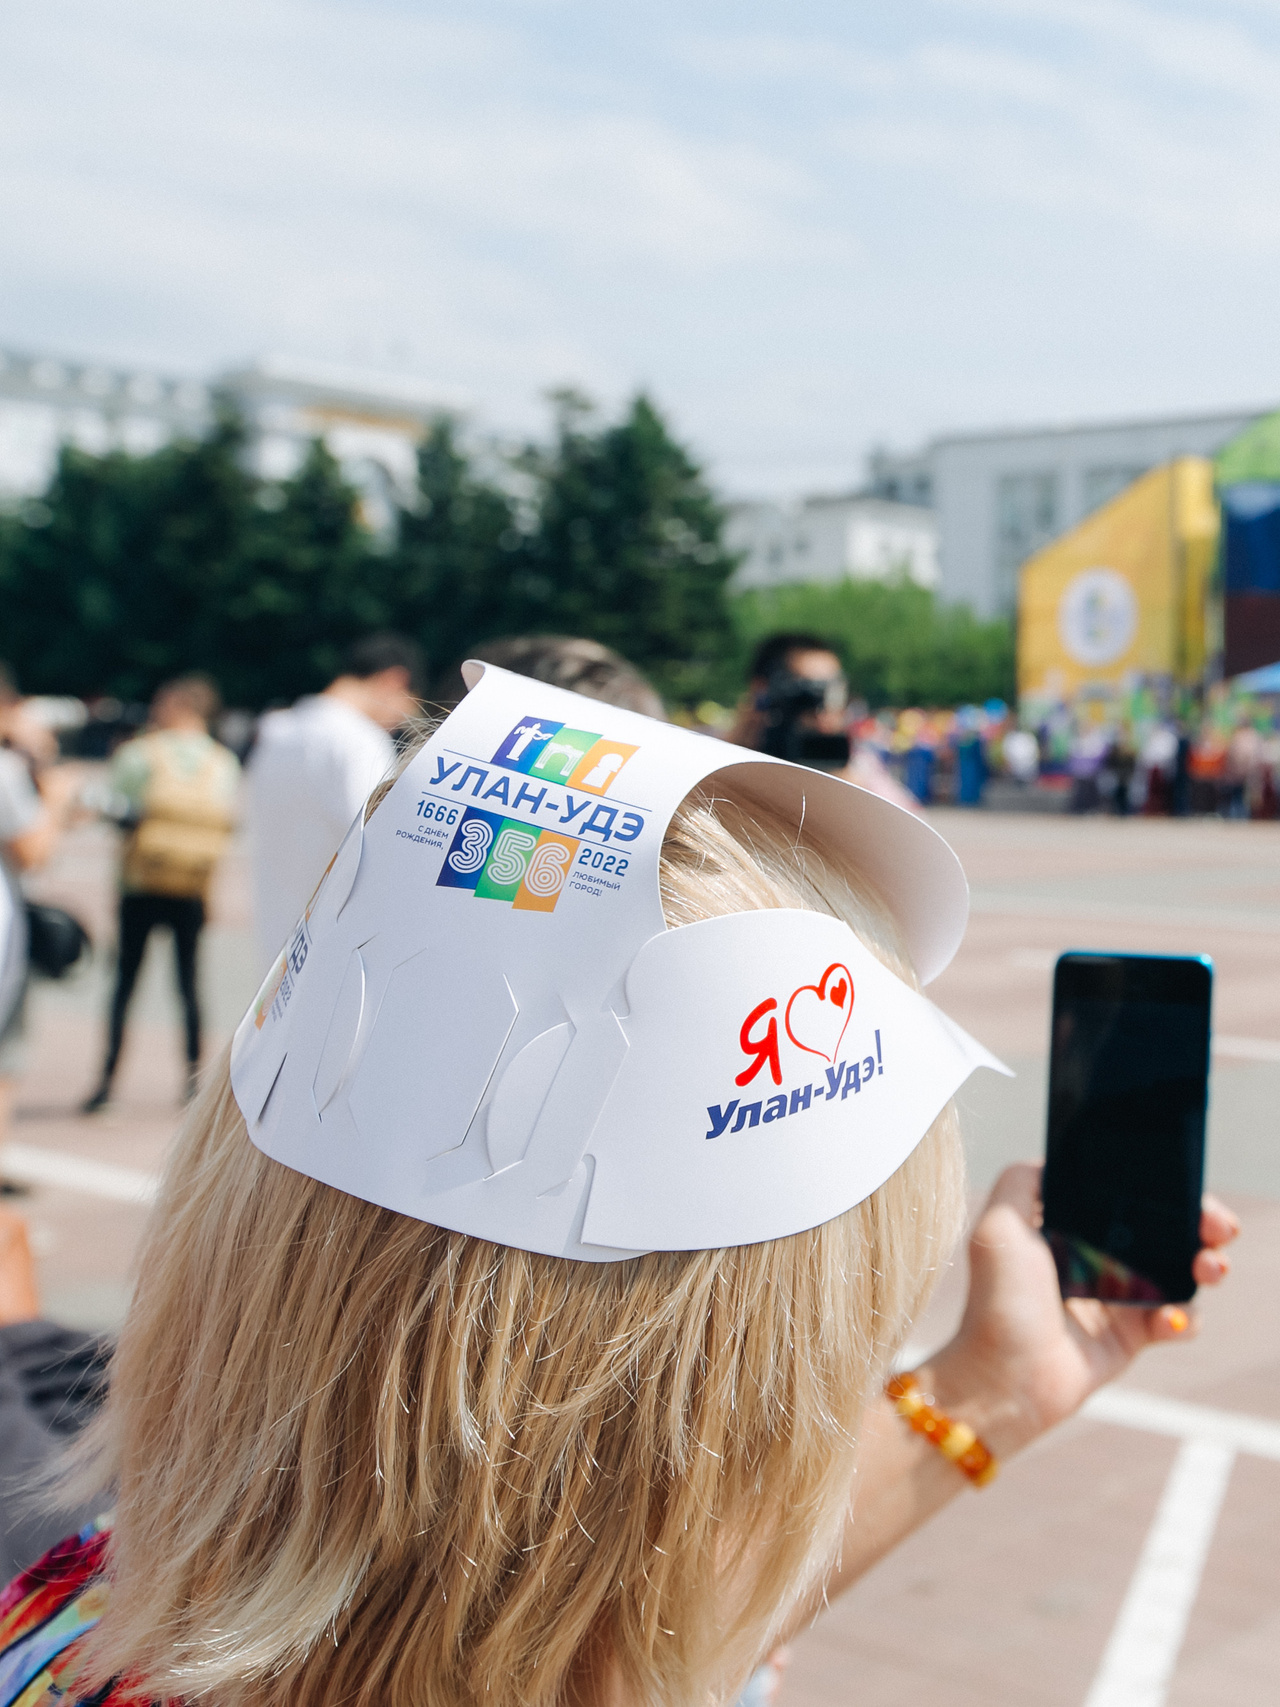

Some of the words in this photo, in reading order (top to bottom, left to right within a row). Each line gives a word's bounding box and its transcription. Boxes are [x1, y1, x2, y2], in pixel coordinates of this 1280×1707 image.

[416, 800, 459, 825] 1666
[429, 756, 645, 843] УЛАН-УДЭ
[396, 830, 444, 850] РОЖДЕНИЯ,
[418, 825, 425, 833] С
[425, 826, 449, 840] ДНЁМ
[448, 818, 570, 897] 356
[578, 848, 629, 877] 2022
[569, 881, 602, 897] ГОРОД!
[572, 871, 621, 891] ЛЮБИМЫЙ
[735, 997, 782, 1087] Я
[705, 1029, 883, 1140] Улан-Удэ!
